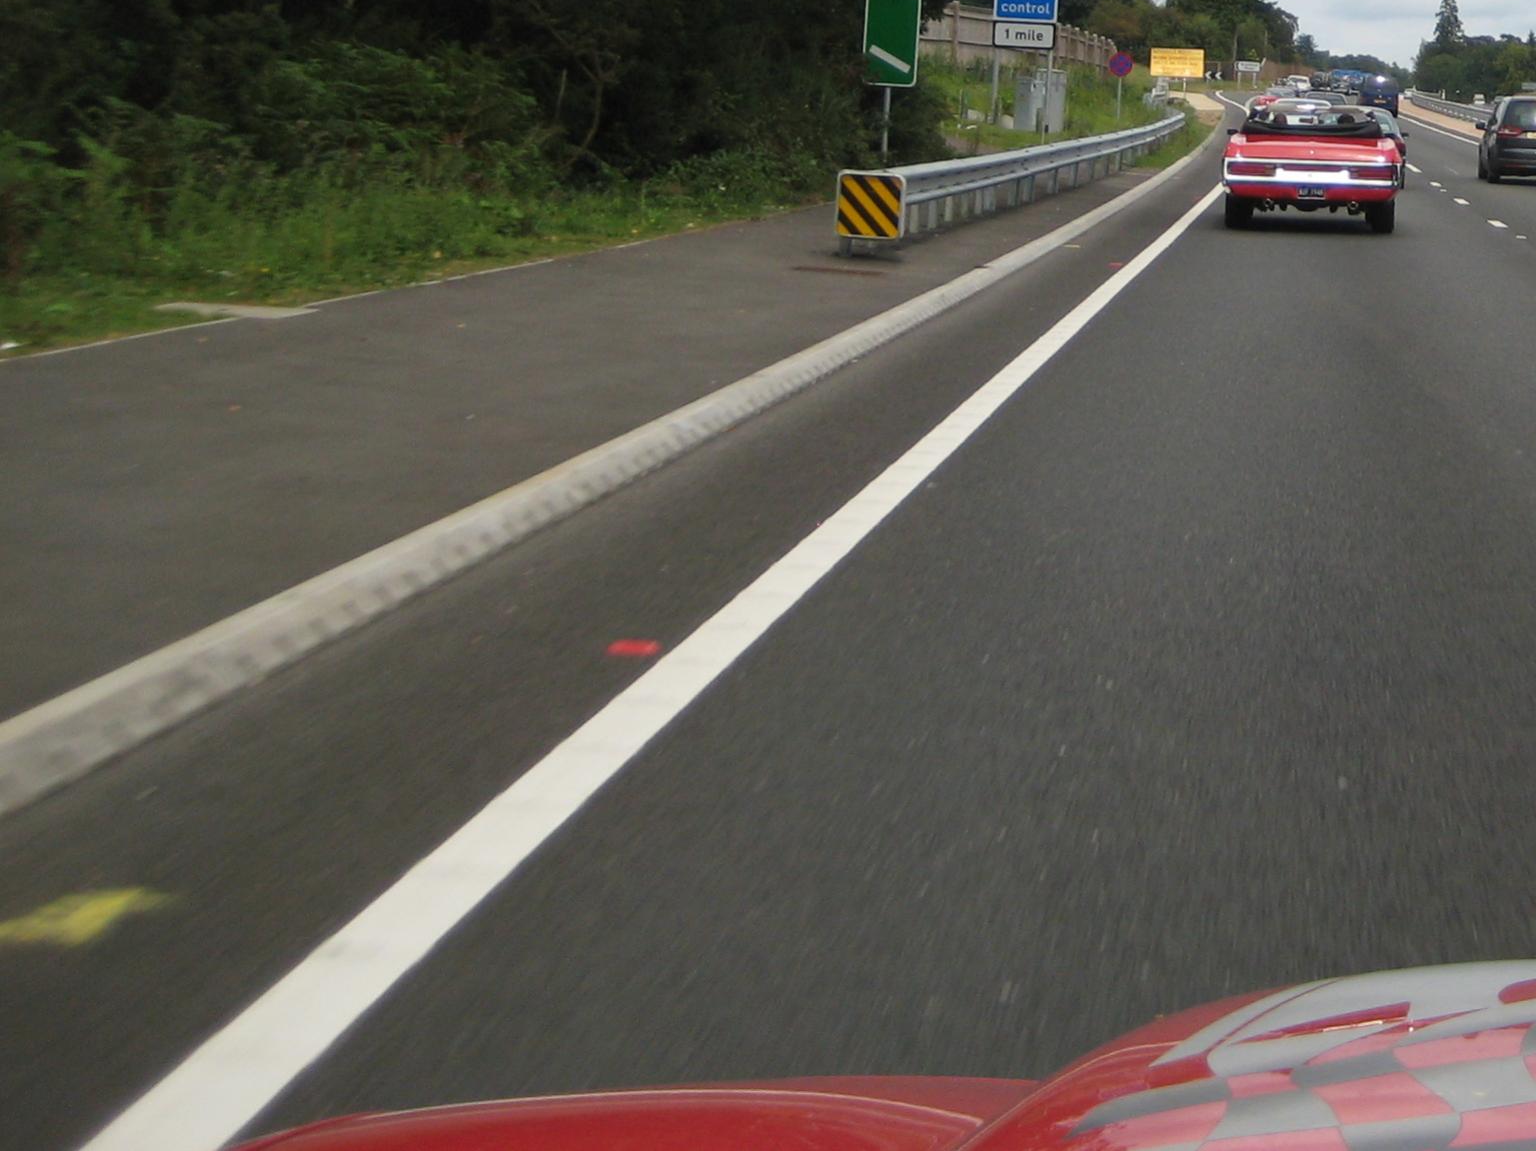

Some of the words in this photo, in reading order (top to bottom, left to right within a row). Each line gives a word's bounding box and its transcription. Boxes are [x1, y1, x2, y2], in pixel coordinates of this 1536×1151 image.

[1001, 2, 1050, 14] control
[1005, 29, 1010, 39] 1
[1015, 30, 1044, 41] mile
